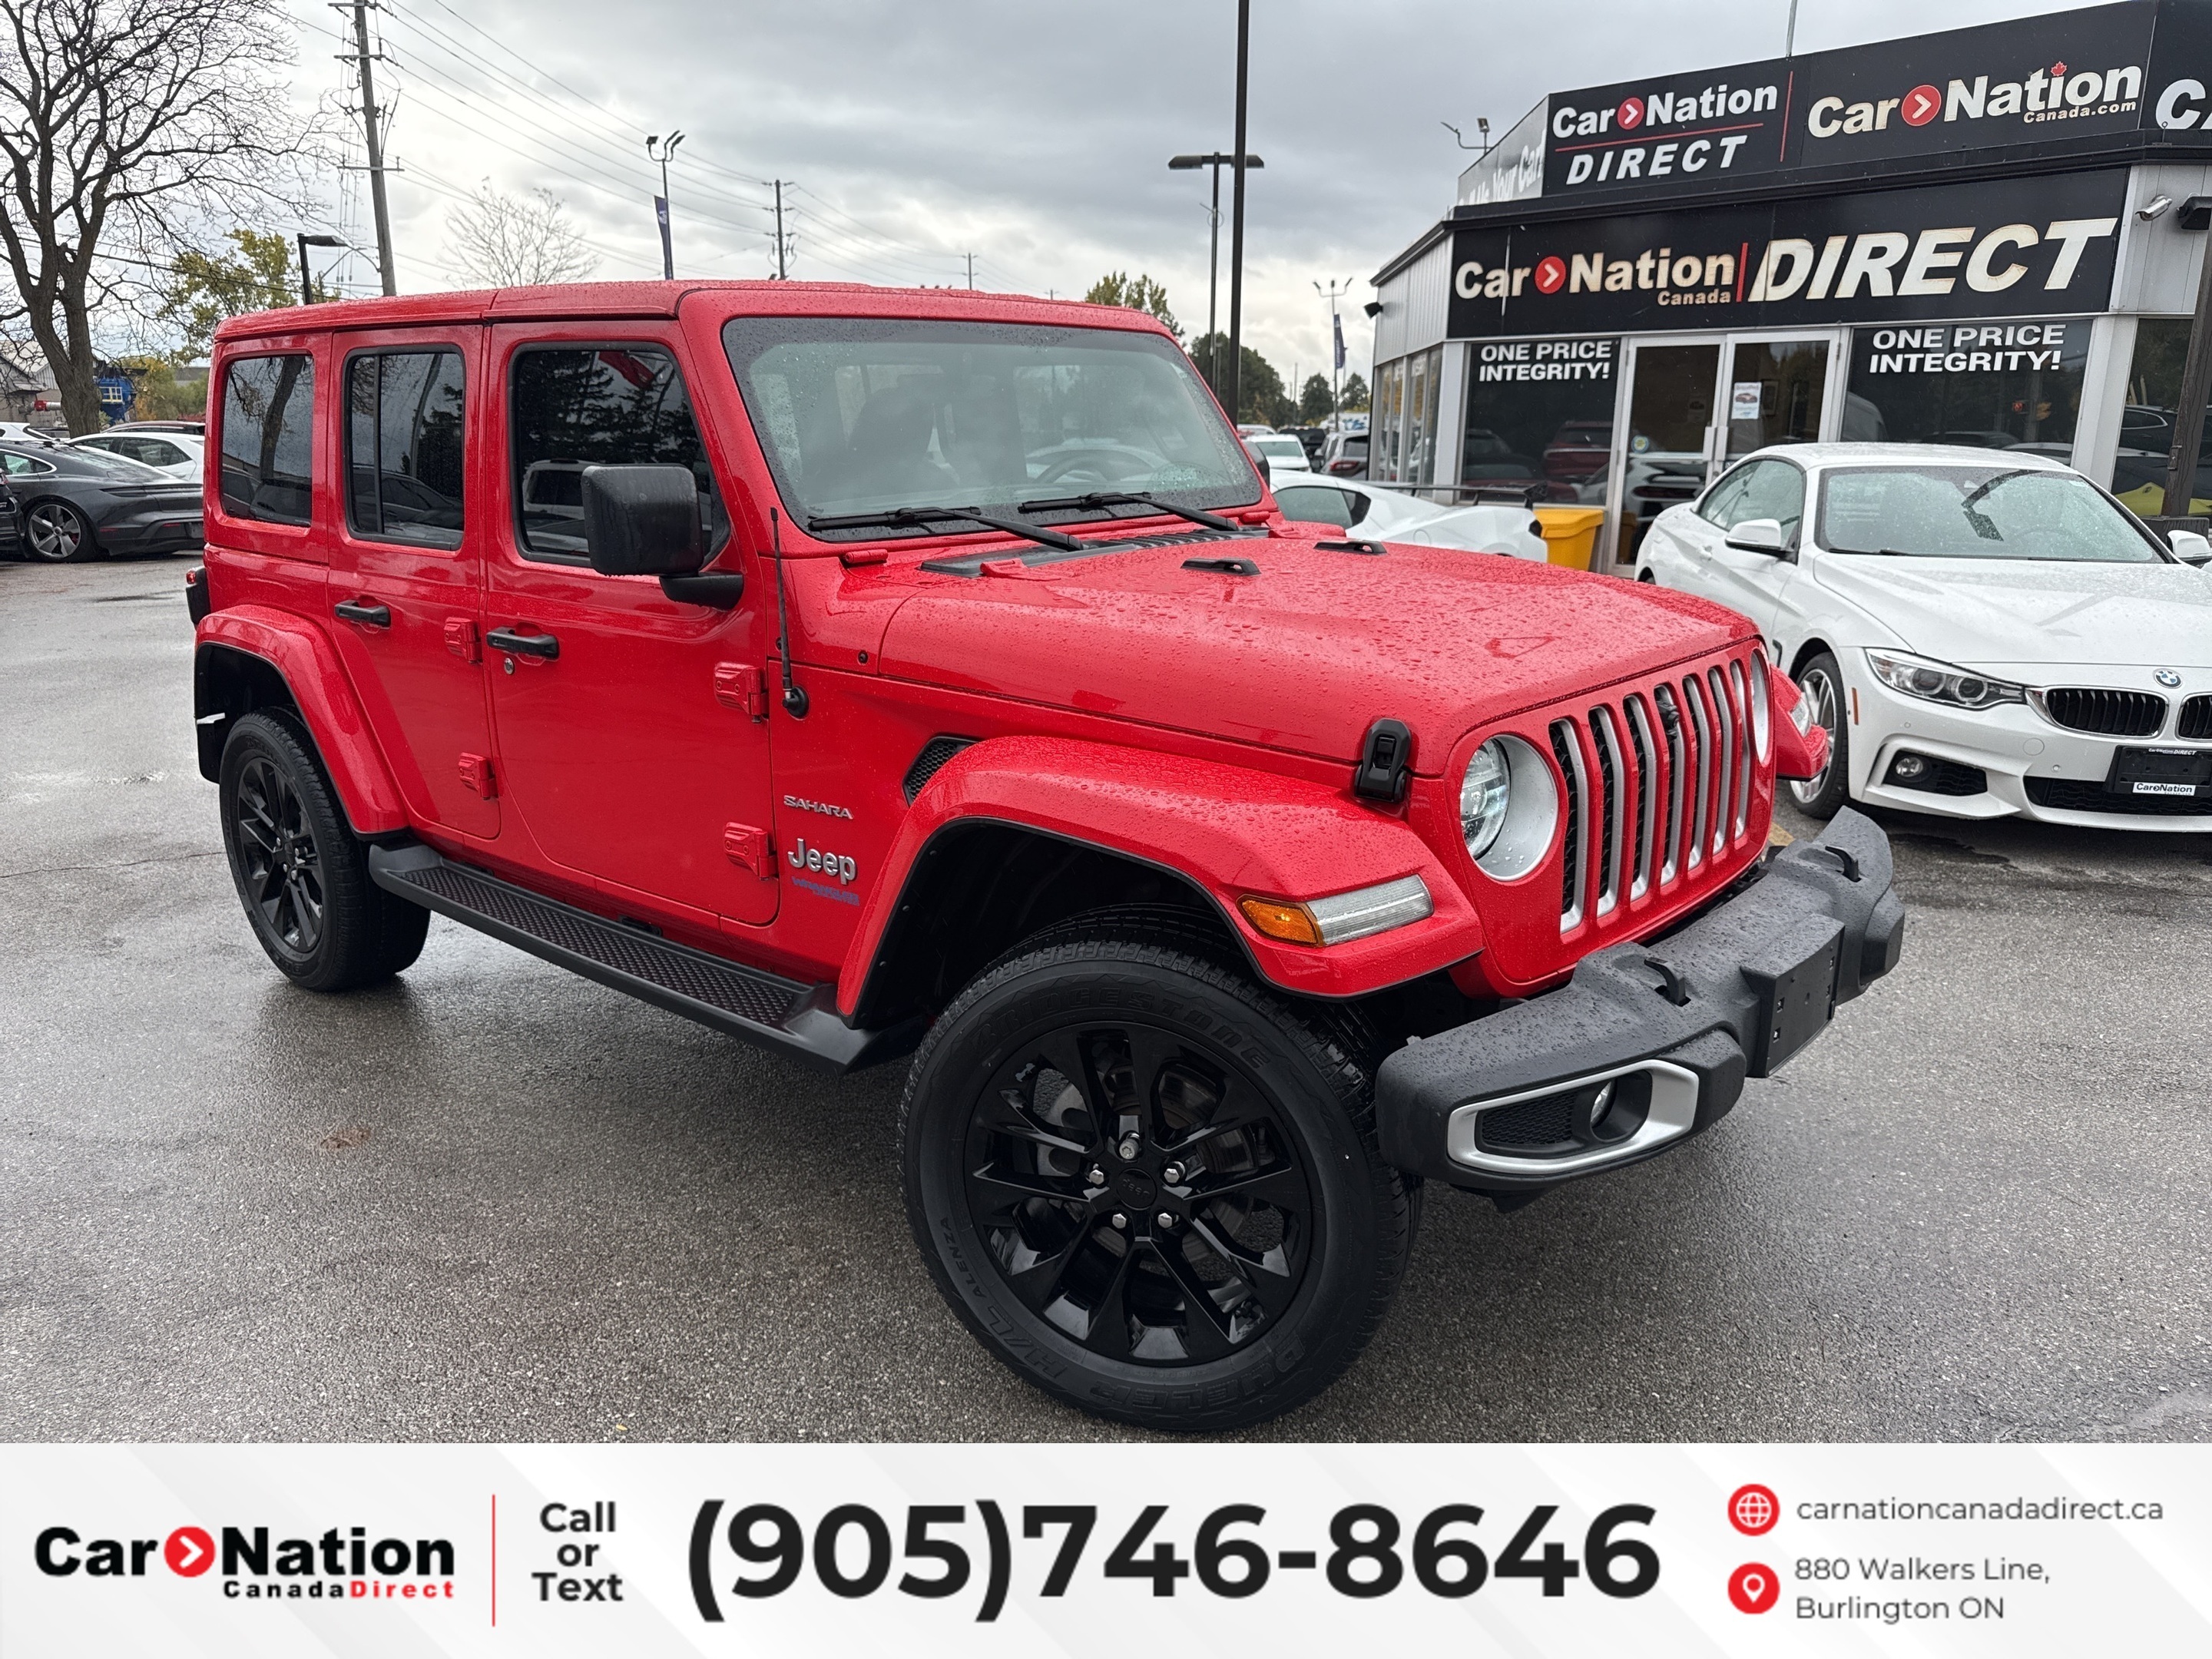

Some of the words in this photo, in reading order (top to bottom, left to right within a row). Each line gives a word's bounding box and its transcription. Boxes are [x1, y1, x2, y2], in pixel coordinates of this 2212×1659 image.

[1552, 106, 1616, 138] Car
[1646, 84, 1777, 127] Nation
[1808, 97, 1899, 137] Car
[1944, 63, 2142, 122] Nation
[2024, 101, 2137, 124] Canada.com
[1566, 134, 1747, 185] DIRECT
[1455, 260, 1532, 300] Car
[1568, 247, 1736, 293] Nation
[1747, 217, 2118, 303] DIRECT
[1657, 288, 1731, 306] Canada
[1872, 328, 1946, 350] ONE
[1953, 324, 2067, 347] PRICE
[1481, 343, 1531, 363] ONE
[1535, 340, 1612, 360] PRICE
[1869, 350, 2062, 374] INTEGRITY!
[1479, 361, 1610, 382] INTEGRITY!
[2160, 784, 2193, 793] Nation
[783, 795, 853, 820] SAHARA
[787, 838, 857, 885] Jeep
[971, 985, 1272, 1071] BRIDGESTONE
[939, 1216, 986, 1300] ALENZA
